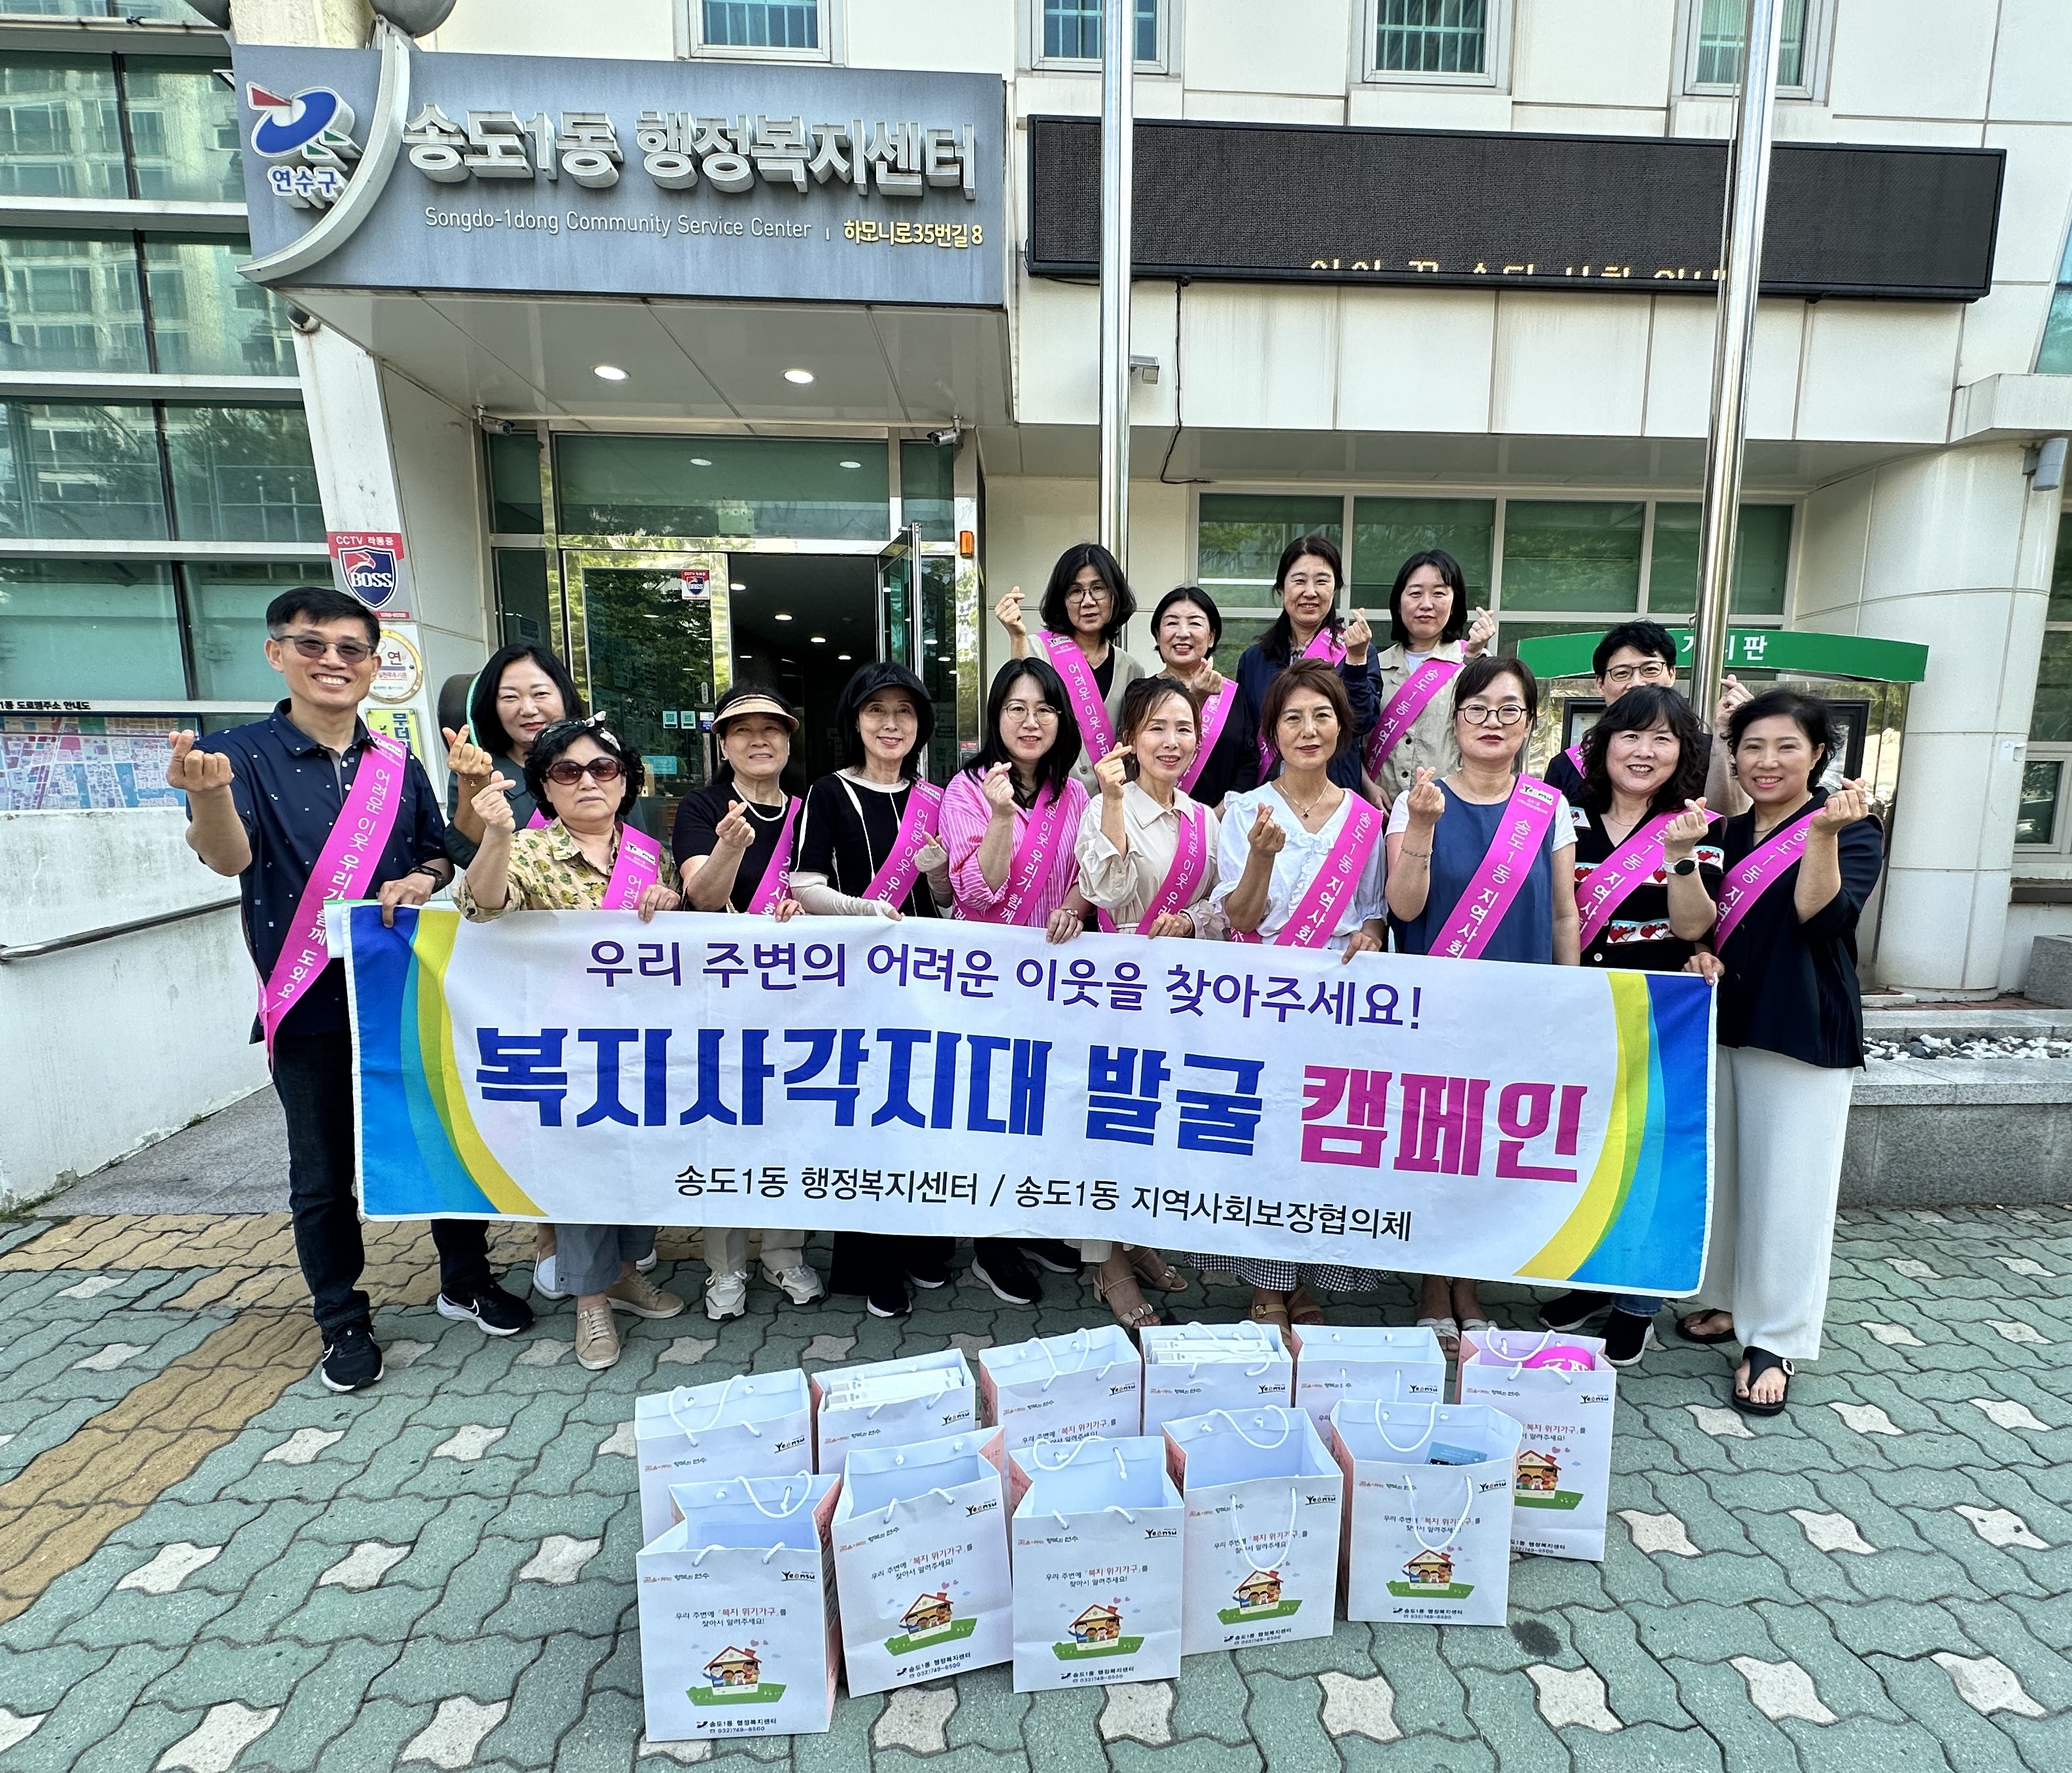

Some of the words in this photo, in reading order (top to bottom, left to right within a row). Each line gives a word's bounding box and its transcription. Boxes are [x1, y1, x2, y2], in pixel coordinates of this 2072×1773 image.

[402, 103, 623, 184] 송도1동
[635, 111, 976, 199] 행정복지센터
[272, 168, 337, 195] 연수구
[425, 207, 559, 234] Songdo-1dong
[566, 211, 671, 238] Community
[677, 215, 744, 236] Service
[751, 218, 812, 238] Center
[843, 219, 968, 249] 하모니로35번길
[971, 224, 984, 245] 8
[336, 536, 364, 545] CCTV
[367, 536, 394, 545] 작동중
[350, 572, 394, 588] BOSS
[63, 700, 91, 710] 안내도
[1067, 661, 1091, 701] 어려운
[1085, 702, 1101, 731] 이웃
[1396, 668, 1439, 717] 송도1동
[365, 767, 390, 816] 어려운
[348, 816, 377, 852] 이웃
[911, 808, 928, 845] 어려운
[1036, 821, 1053, 850] 이웃
[1338, 812, 1372, 874] 송도1동
[1491, 819, 1532, 884] 송도1동
[1742, 826, 1810, 883] 송도1동
[896, 846, 919, 876] 이웃
[1016, 849, 1043, 893] 우리가
[1175, 858, 1195, 890] 이웃
[999, 893, 1023, 925] 함께
[1290, 875, 1345, 947] 지역사회
[586, 940, 681, 988] 우리
[702, 942, 845, 990] 주변의
[867, 942, 1000, 998] 어려운
[1016, 958, 1148, 1011] 이웃을
[1165, 963, 1421, 1030] 찾아주세요!
[476, 1027, 1053, 1136] 복지사각지대
[1085, 1044, 1265, 1156] 발굴
[1300, 1063, 1588, 1183] 캠페인
[674, 1165, 789, 1198] 송도1동
[801, 1166, 979, 1205] 행정복지센터
[989, 1173, 1006, 1207] /
[1015, 1175, 1120, 1211] 송도1동
[1130, 1185, 1412, 1242] 지역사회보장협의체
[1022, 1436, 1034, 1444] 우리
[1214, 1541, 1226, 1549] 우리
[870, 1570, 885, 1580] 우리
[887, 1562, 908, 1575] 주변에
[895, 1568, 916, 1581] 찾아서
[917, 1558, 954, 1574] 알려주세요!
[1045, 1573, 1059, 1581] 우리
[1061, 1571, 1082, 1580] 주변에
[1069, 1579, 1090, 1589] 찾아서
[1092, 1576, 1128, 1587] 알려주세요!
[675, 1611, 690, 1621] 우리
[693, 1610, 715, 1619] 주변에
[702, 1619, 724, 1628] 찾아서
[726, 1618, 765, 1627] 알려주세요!
